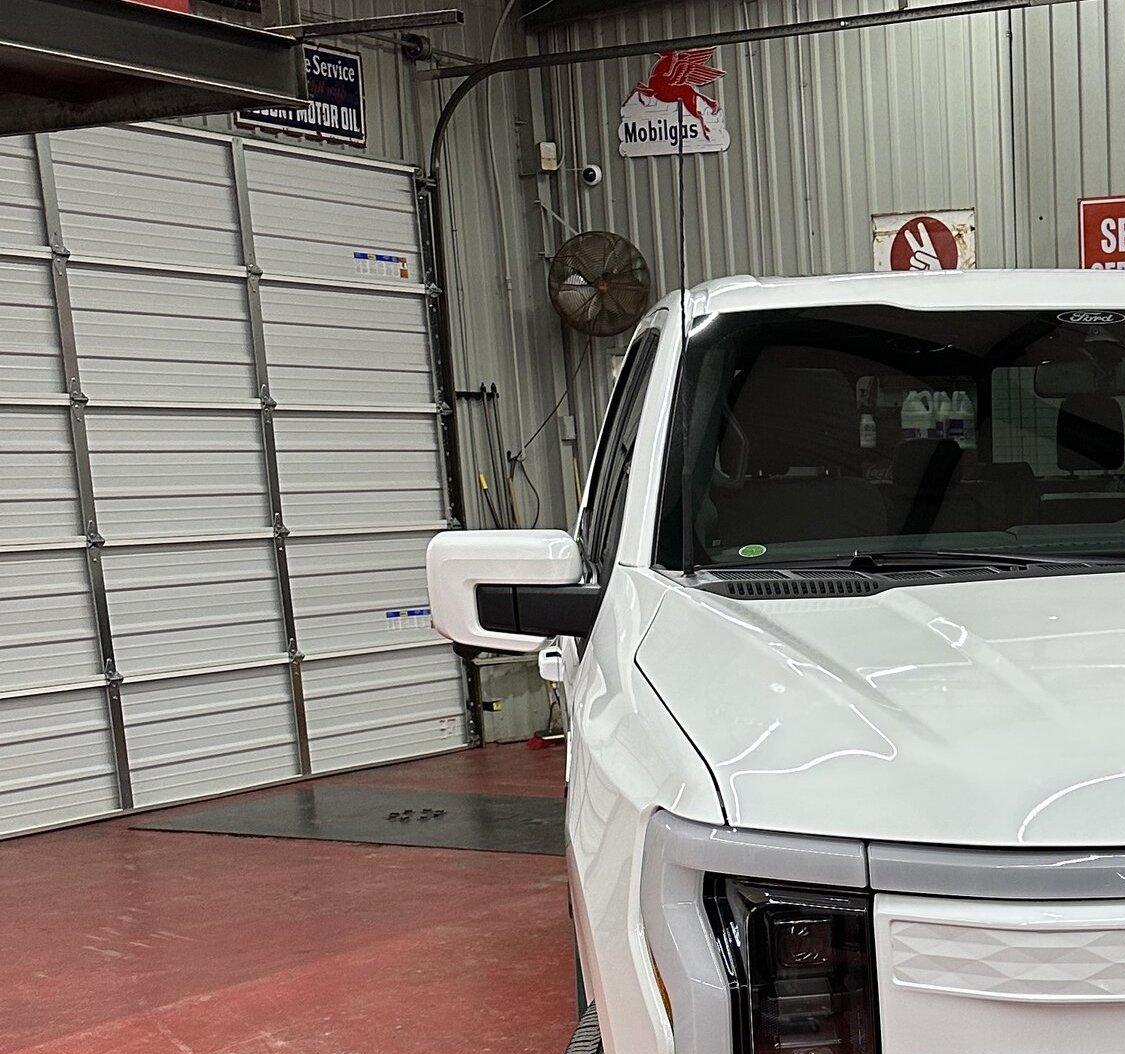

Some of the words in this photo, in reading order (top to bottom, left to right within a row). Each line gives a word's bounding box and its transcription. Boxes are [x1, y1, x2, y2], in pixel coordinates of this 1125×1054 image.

[312, 54, 355, 82] Service
[341, 106, 360, 132] OIL
[624, 120, 699, 147] Mobilgas
[1069, 312, 1115, 322] Ford
